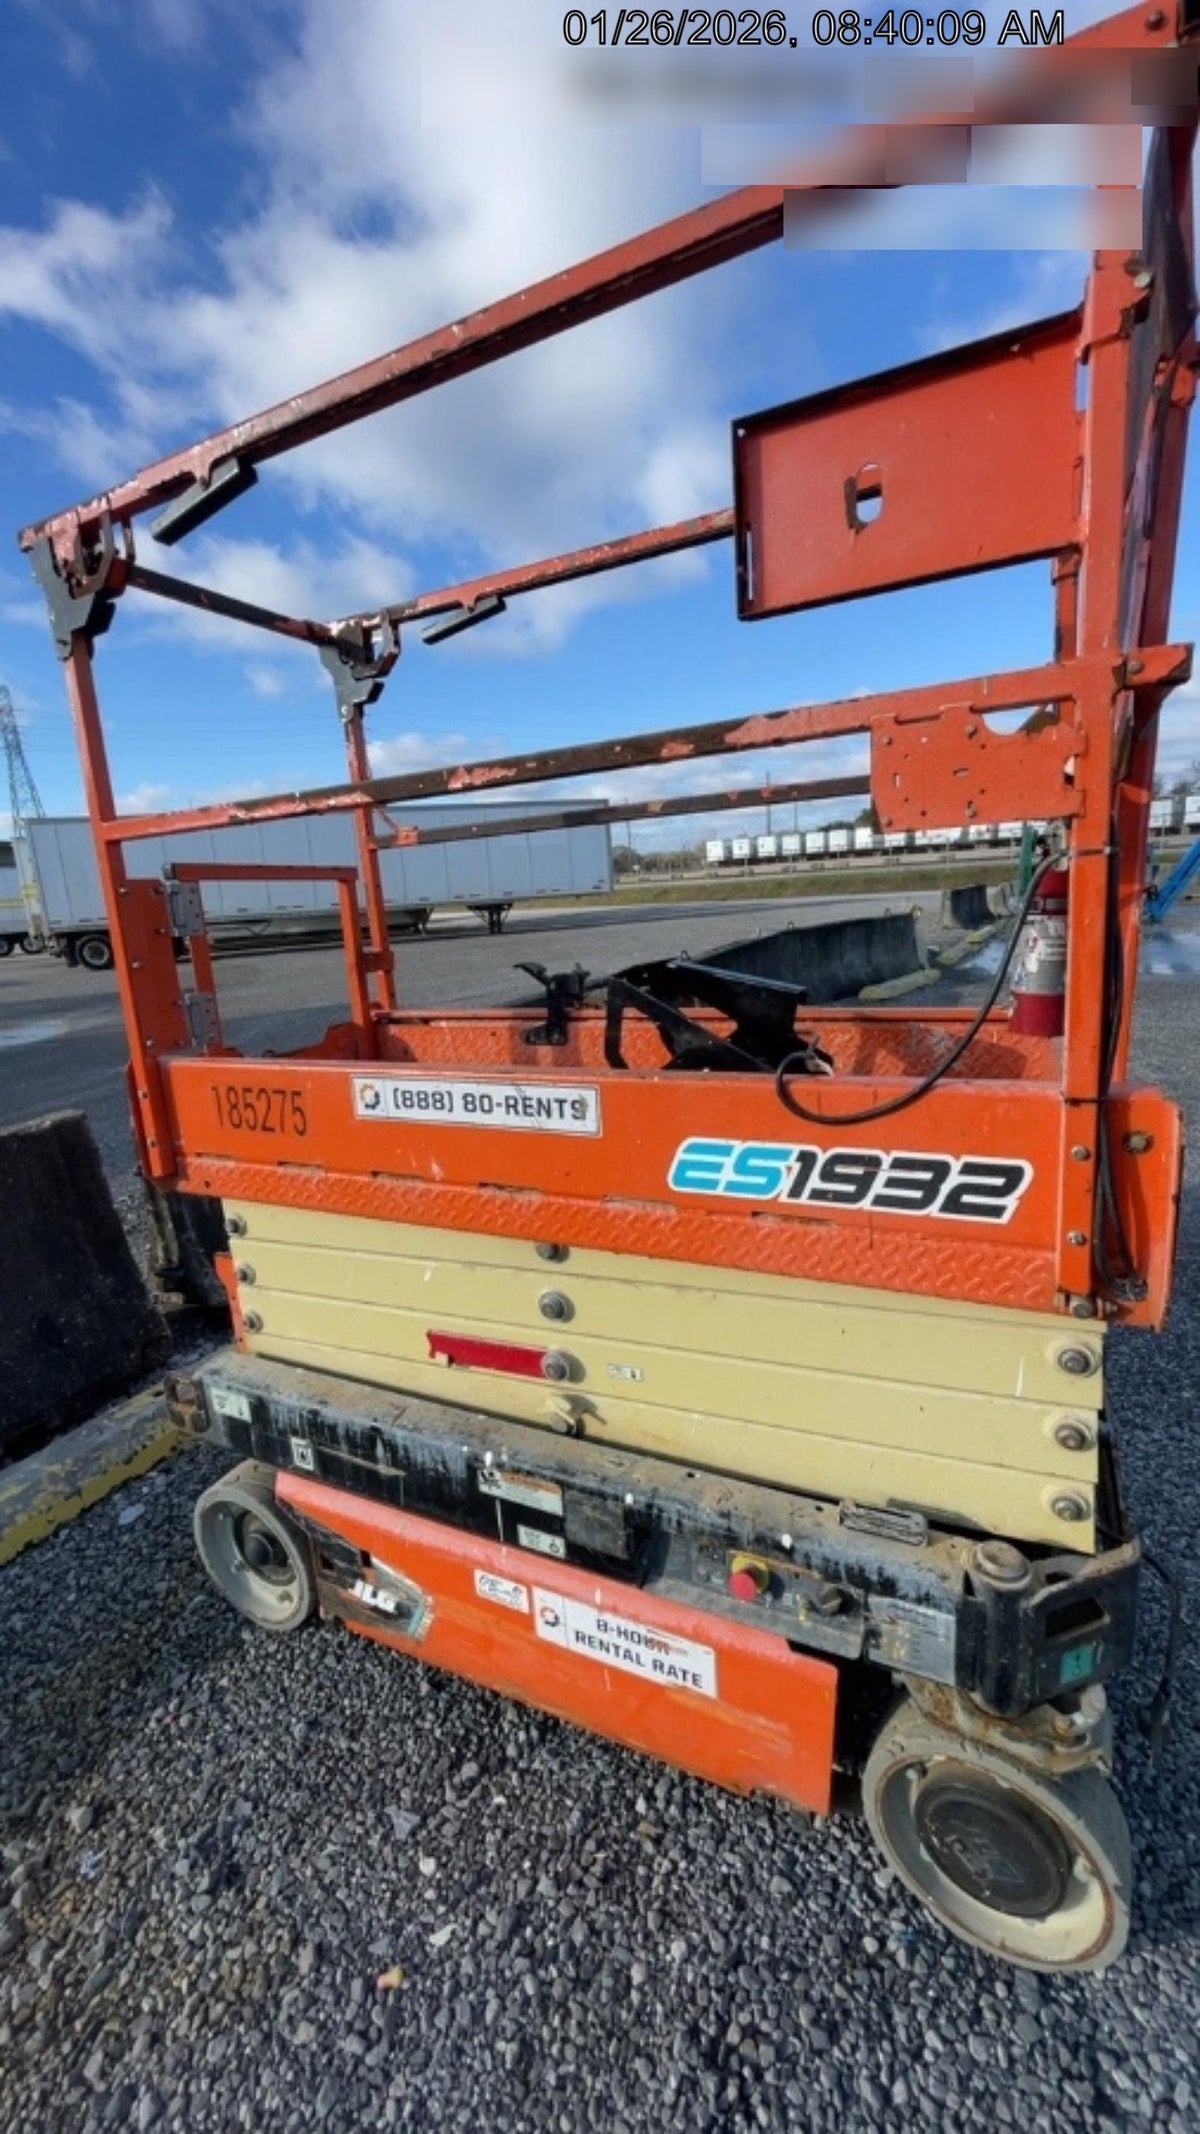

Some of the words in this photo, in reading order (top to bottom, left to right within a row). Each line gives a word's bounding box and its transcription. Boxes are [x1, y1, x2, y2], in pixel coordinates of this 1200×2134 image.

[211, 1086, 307, 1136] 185275
[393, 1087, 454, 1113] (888)
[462, 1093, 589, 1121] 80-RENTS
[671, 1140, 1027, 1220] ES1932
[575, 1630, 645, 1668] RENTAL
[651, 1658, 703, 1689] RATE
